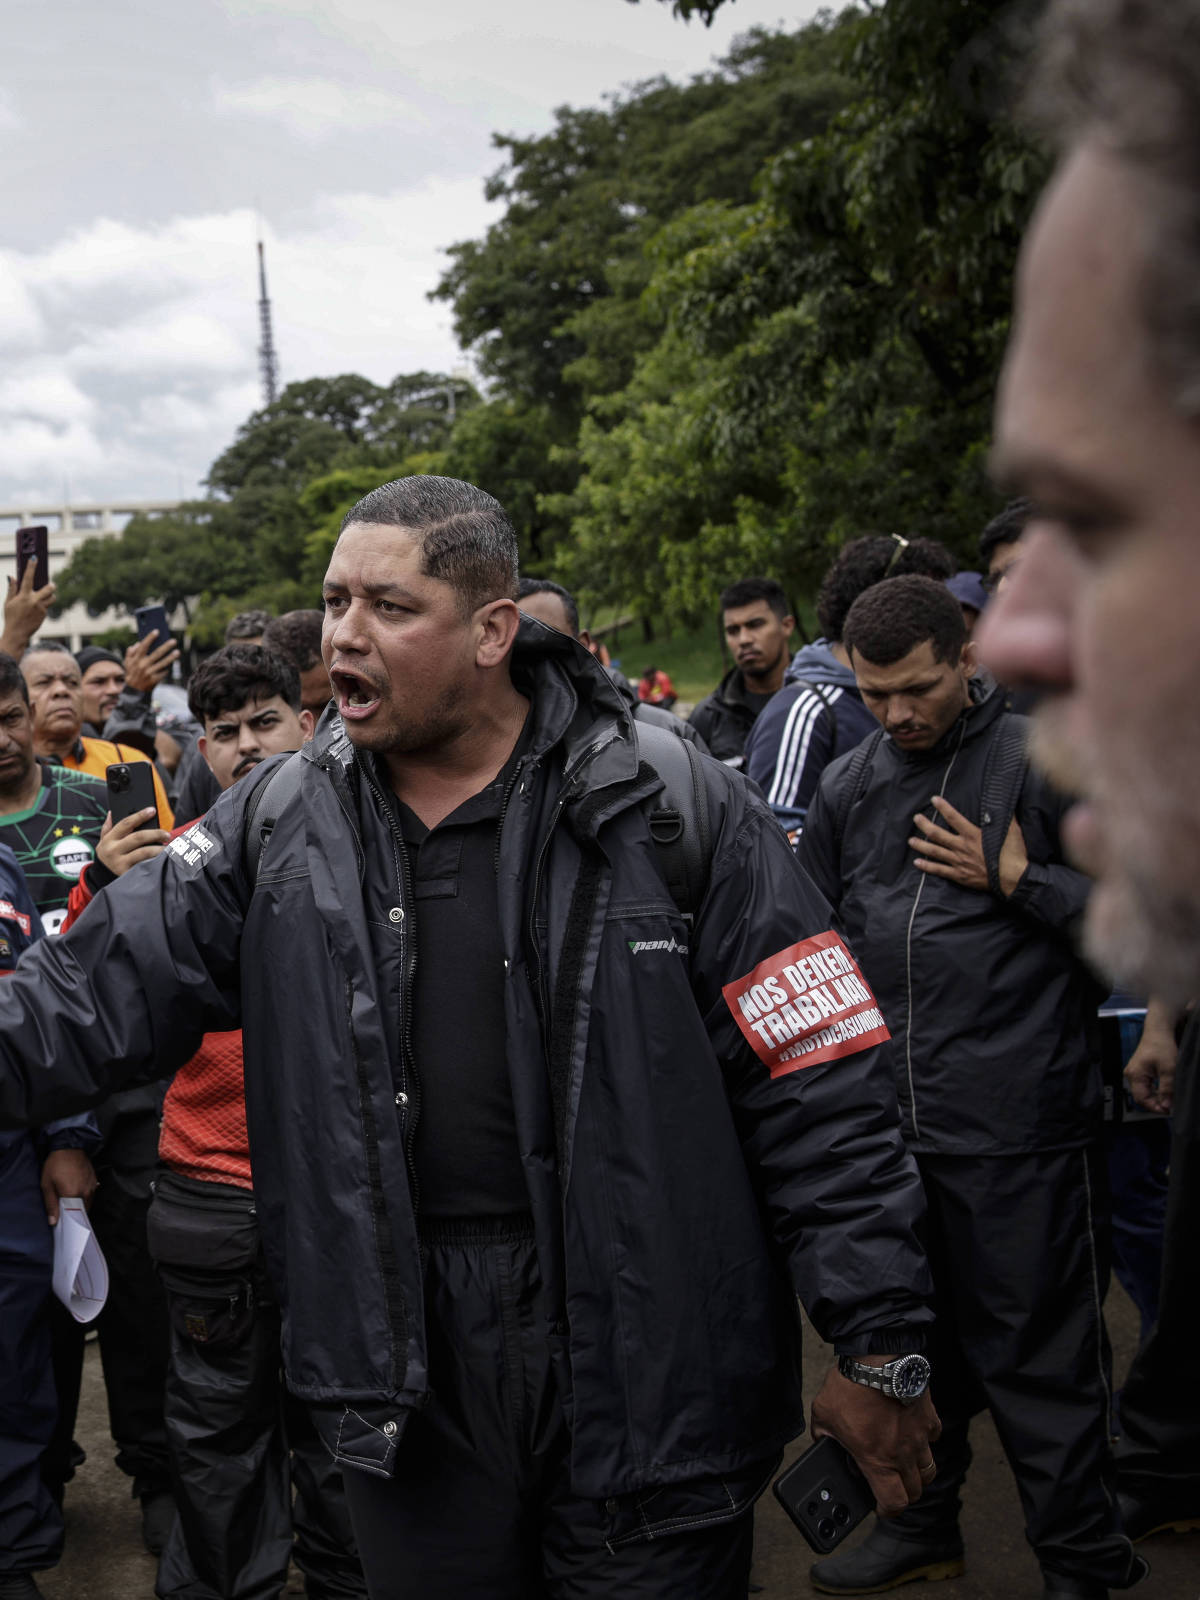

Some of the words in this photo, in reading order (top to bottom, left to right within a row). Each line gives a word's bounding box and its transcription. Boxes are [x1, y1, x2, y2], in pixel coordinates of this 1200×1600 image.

[183, 848, 202, 866] JÁ!
[737, 976, 788, 1023] NOS
[782, 945, 854, 995] DEIXEM
[751, 973, 872, 1050] TRABALHAR
[778, 1007, 885, 1062] #MOTOCASUNIDOS
